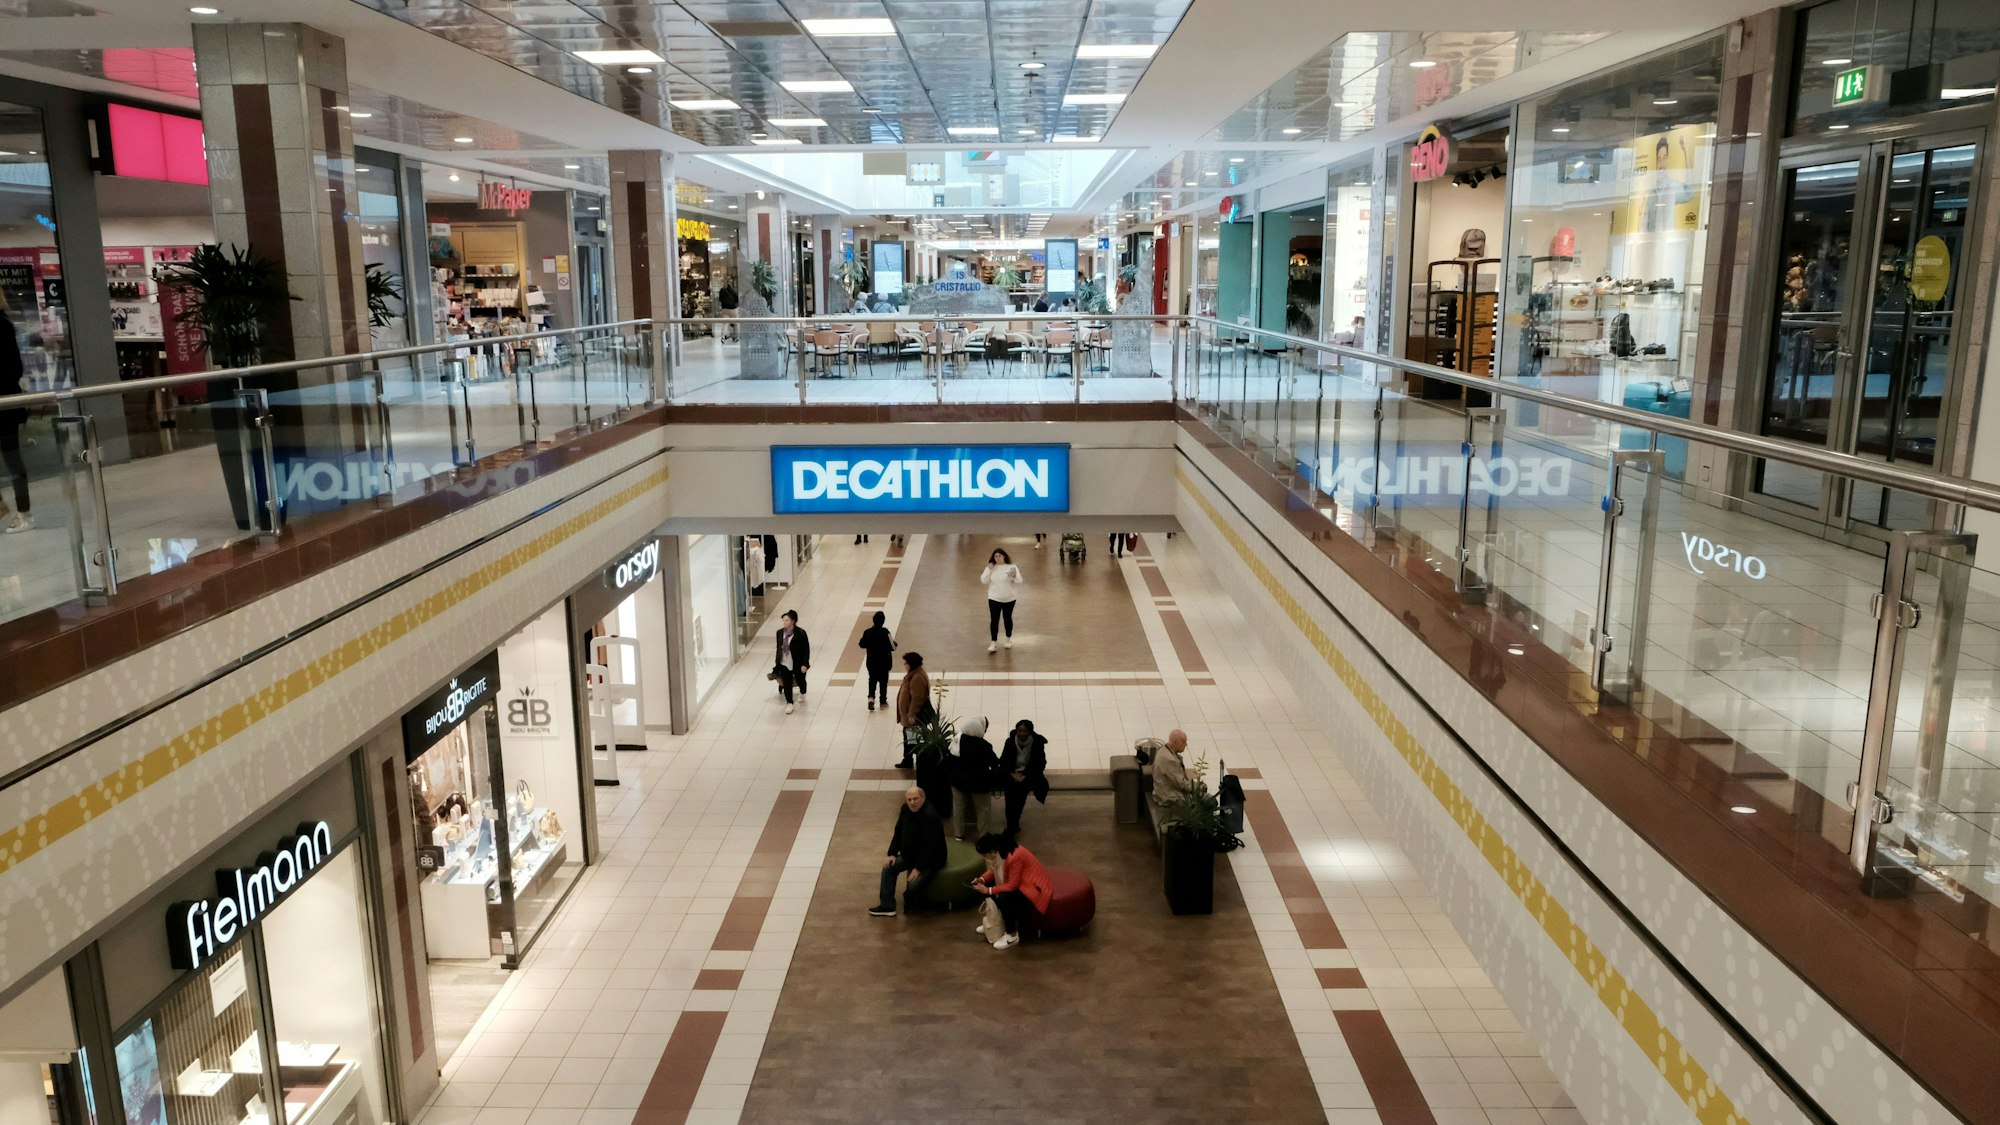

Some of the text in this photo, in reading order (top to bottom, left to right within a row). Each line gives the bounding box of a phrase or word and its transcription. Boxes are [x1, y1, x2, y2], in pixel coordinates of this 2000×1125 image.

[1411, 136, 1449, 181] RENO
[480, 182, 532, 217] McPaper
[934, 282, 981, 292] CRISTALLO
[792, 459, 1049, 499] DECATHLON
[616, 539, 660, 589] orsay
[426, 706, 447, 735] BIJOU
[186, 820, 332, 970] fielmann
